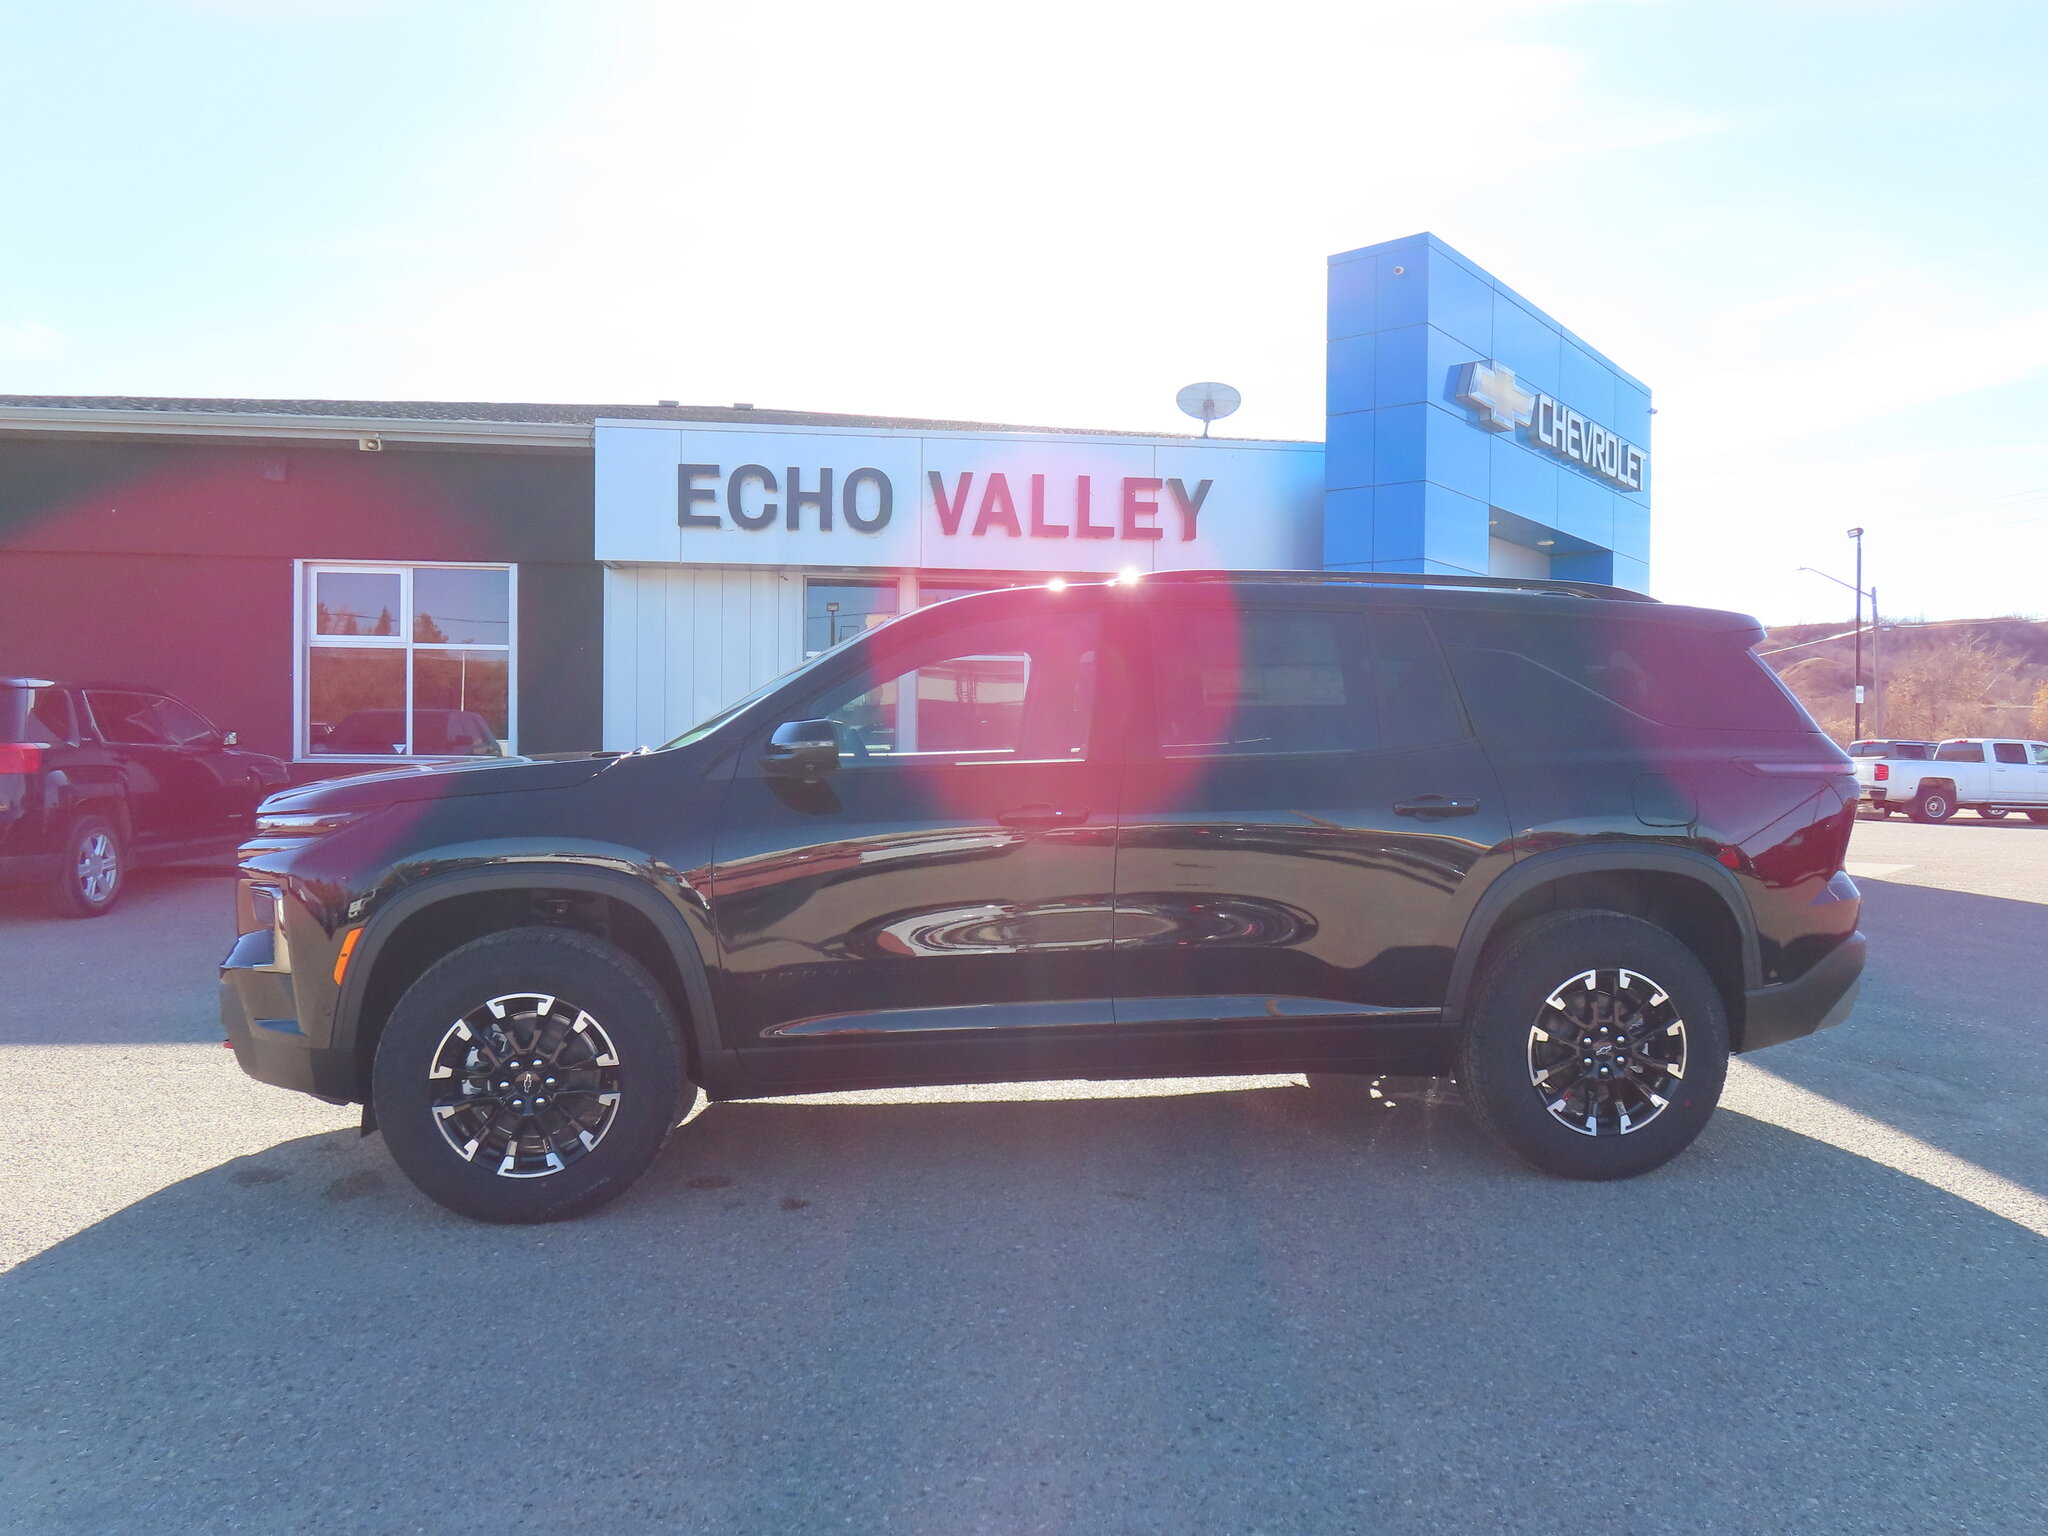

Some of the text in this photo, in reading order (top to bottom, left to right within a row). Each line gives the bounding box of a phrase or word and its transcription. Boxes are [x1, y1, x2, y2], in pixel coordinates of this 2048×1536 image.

[1537, 393, 1647, 491] CHEVROLET
[677, 463, 1214, 541] ECHO VALLEY
